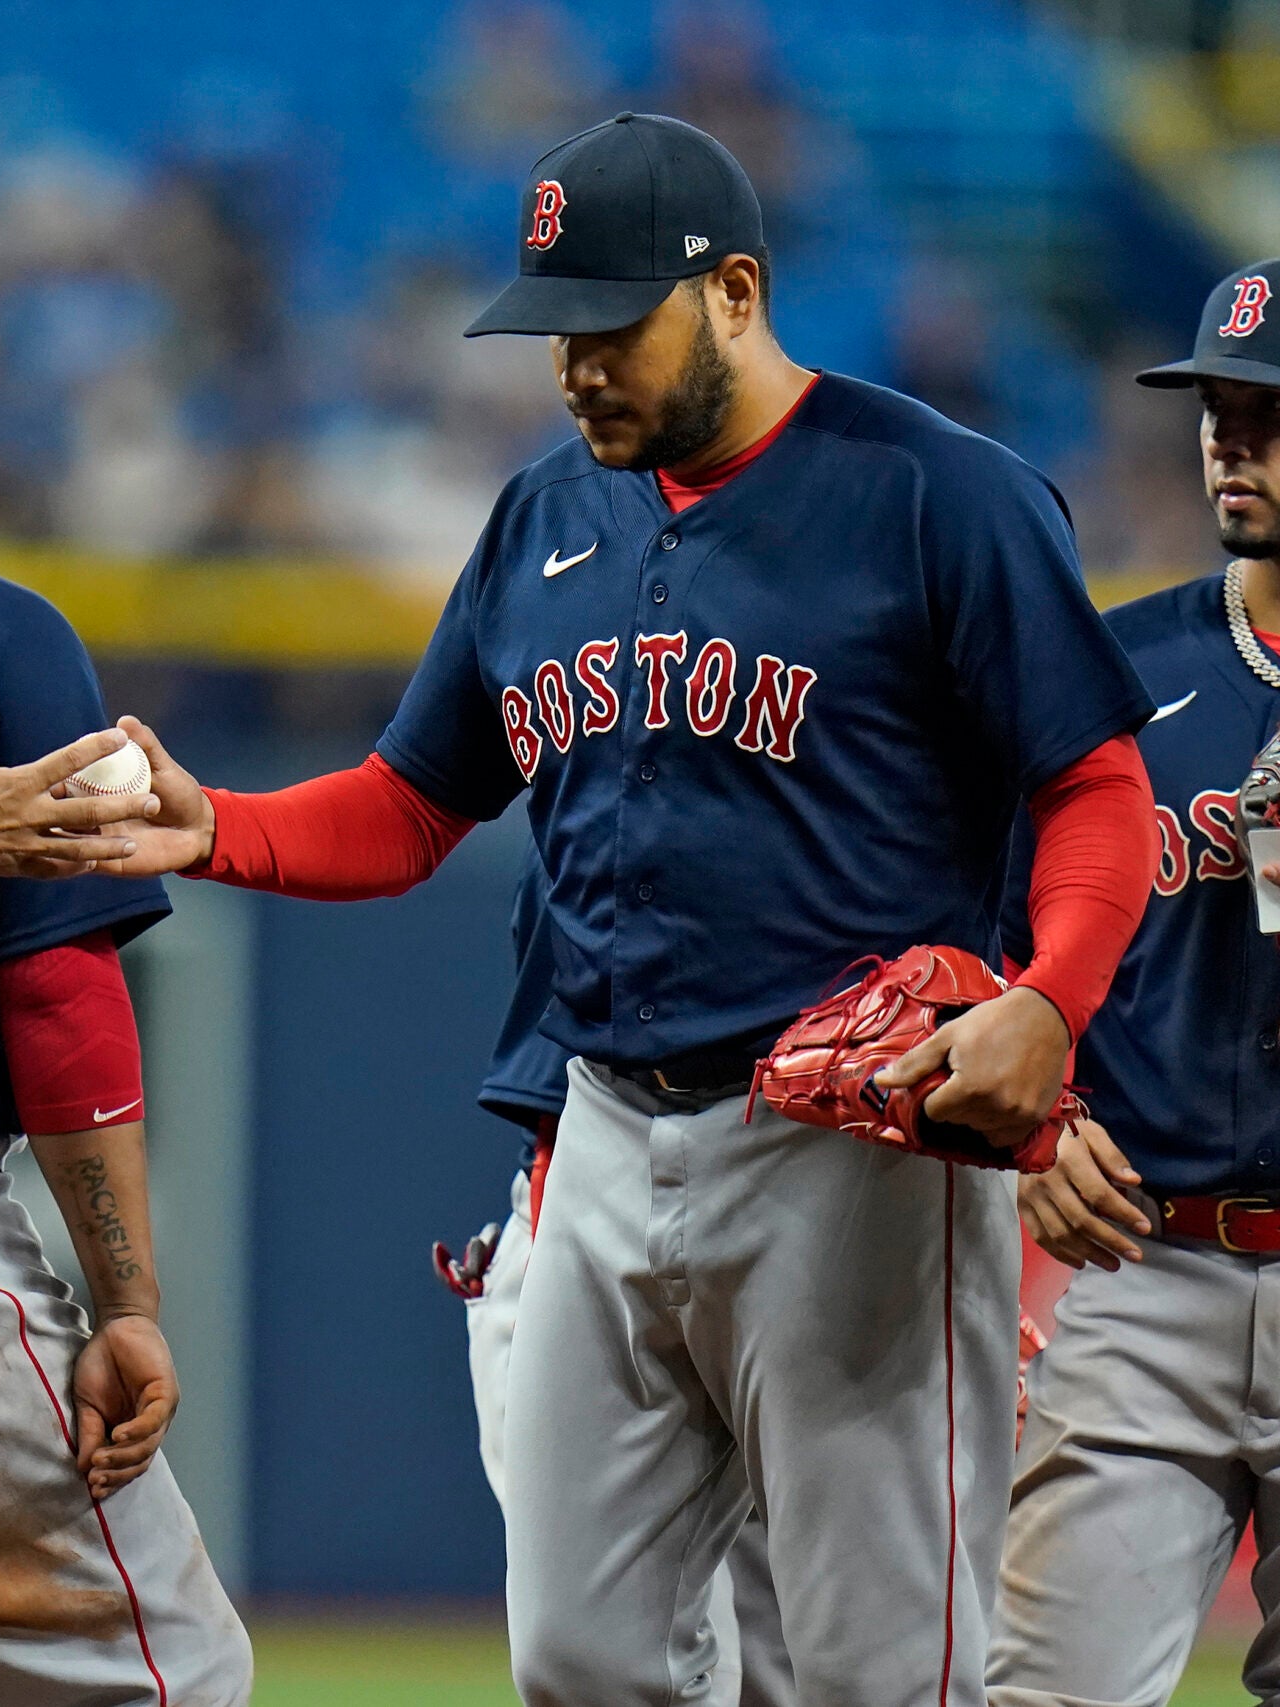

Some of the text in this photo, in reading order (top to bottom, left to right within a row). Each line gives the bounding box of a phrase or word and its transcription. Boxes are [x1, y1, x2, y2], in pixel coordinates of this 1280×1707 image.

[526, 180, 568, 251] B
[1218, 275, 1273, 338] B
[502, 629, 818, 784] BOSTON
